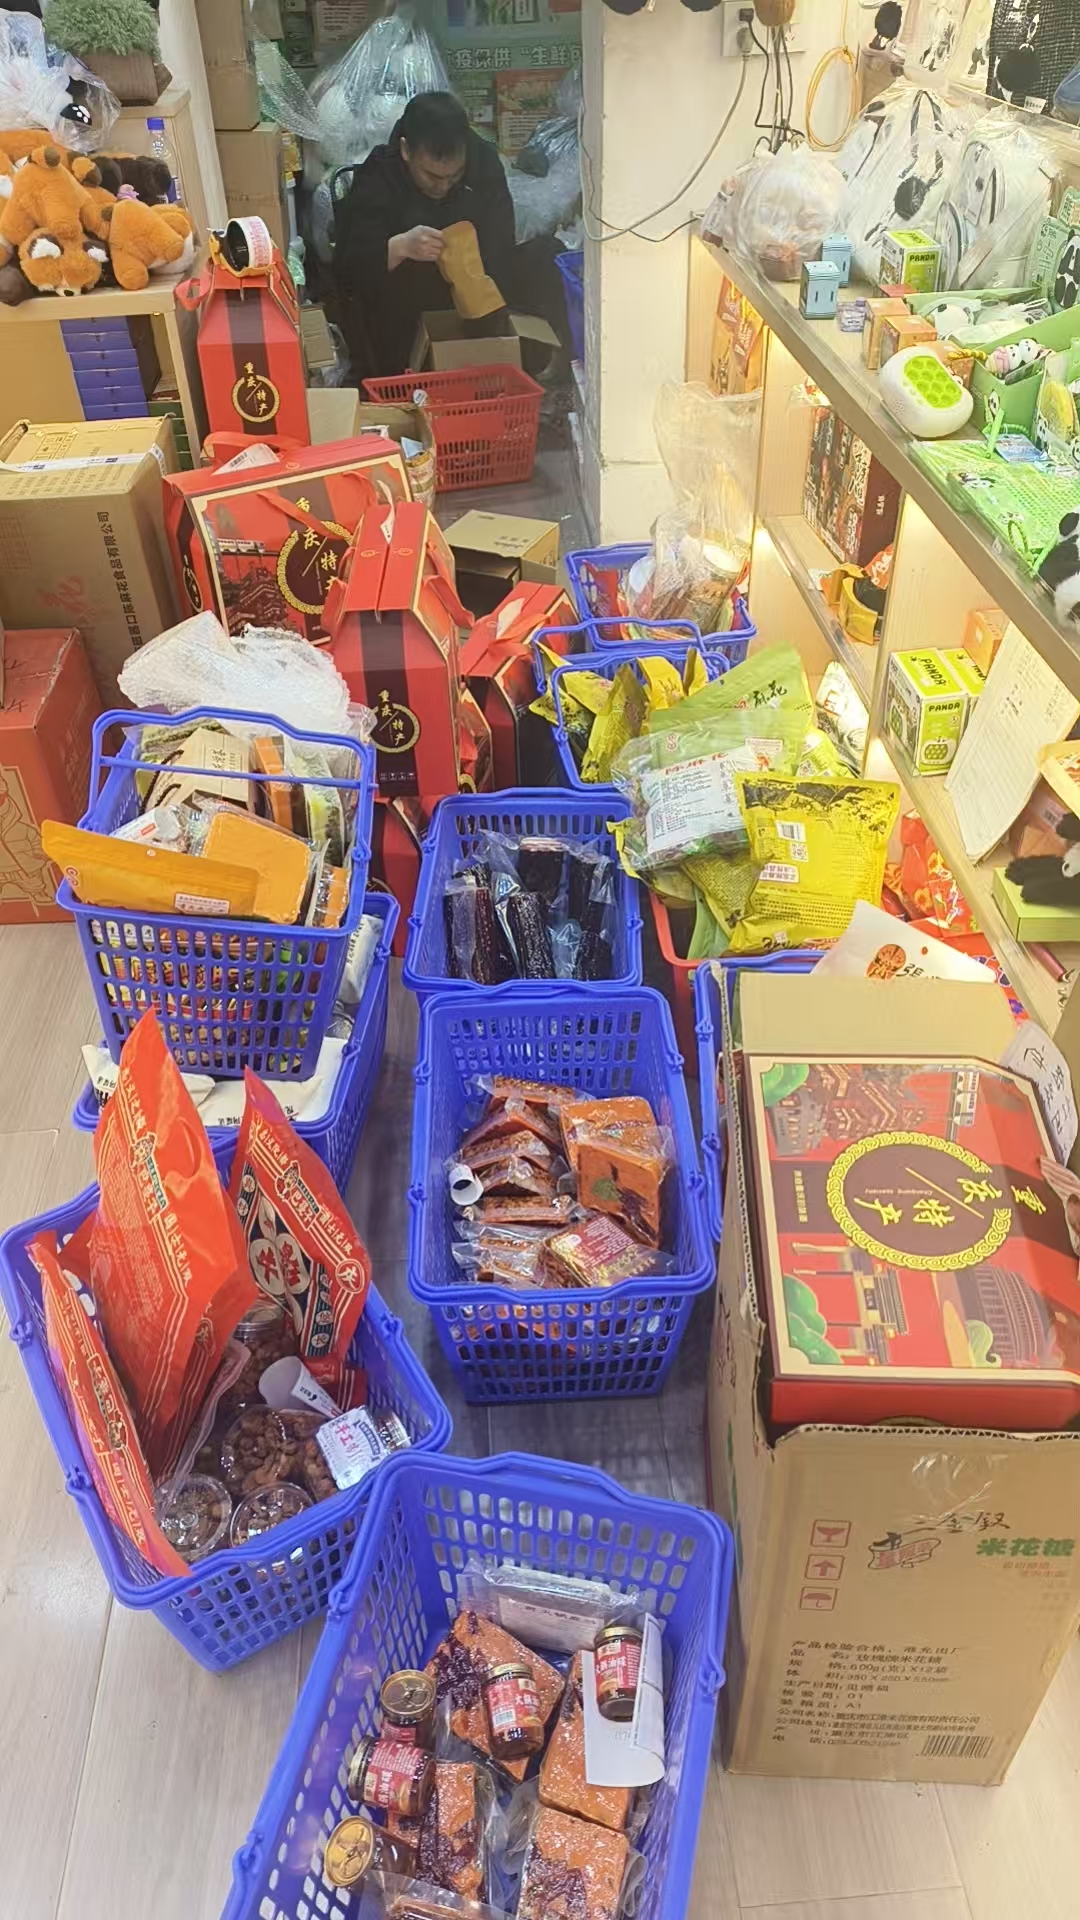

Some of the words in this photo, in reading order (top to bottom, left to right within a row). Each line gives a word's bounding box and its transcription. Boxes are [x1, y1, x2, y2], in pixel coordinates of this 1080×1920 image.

[448, 48, 511, 69] 疫保供
[909, 254, 936, 262] PANDA
[919, 658, 948, 686] PANDA
[928, 702, 961, 712] PANDA
[976, 1537, 1075, 1558] 米花糖
